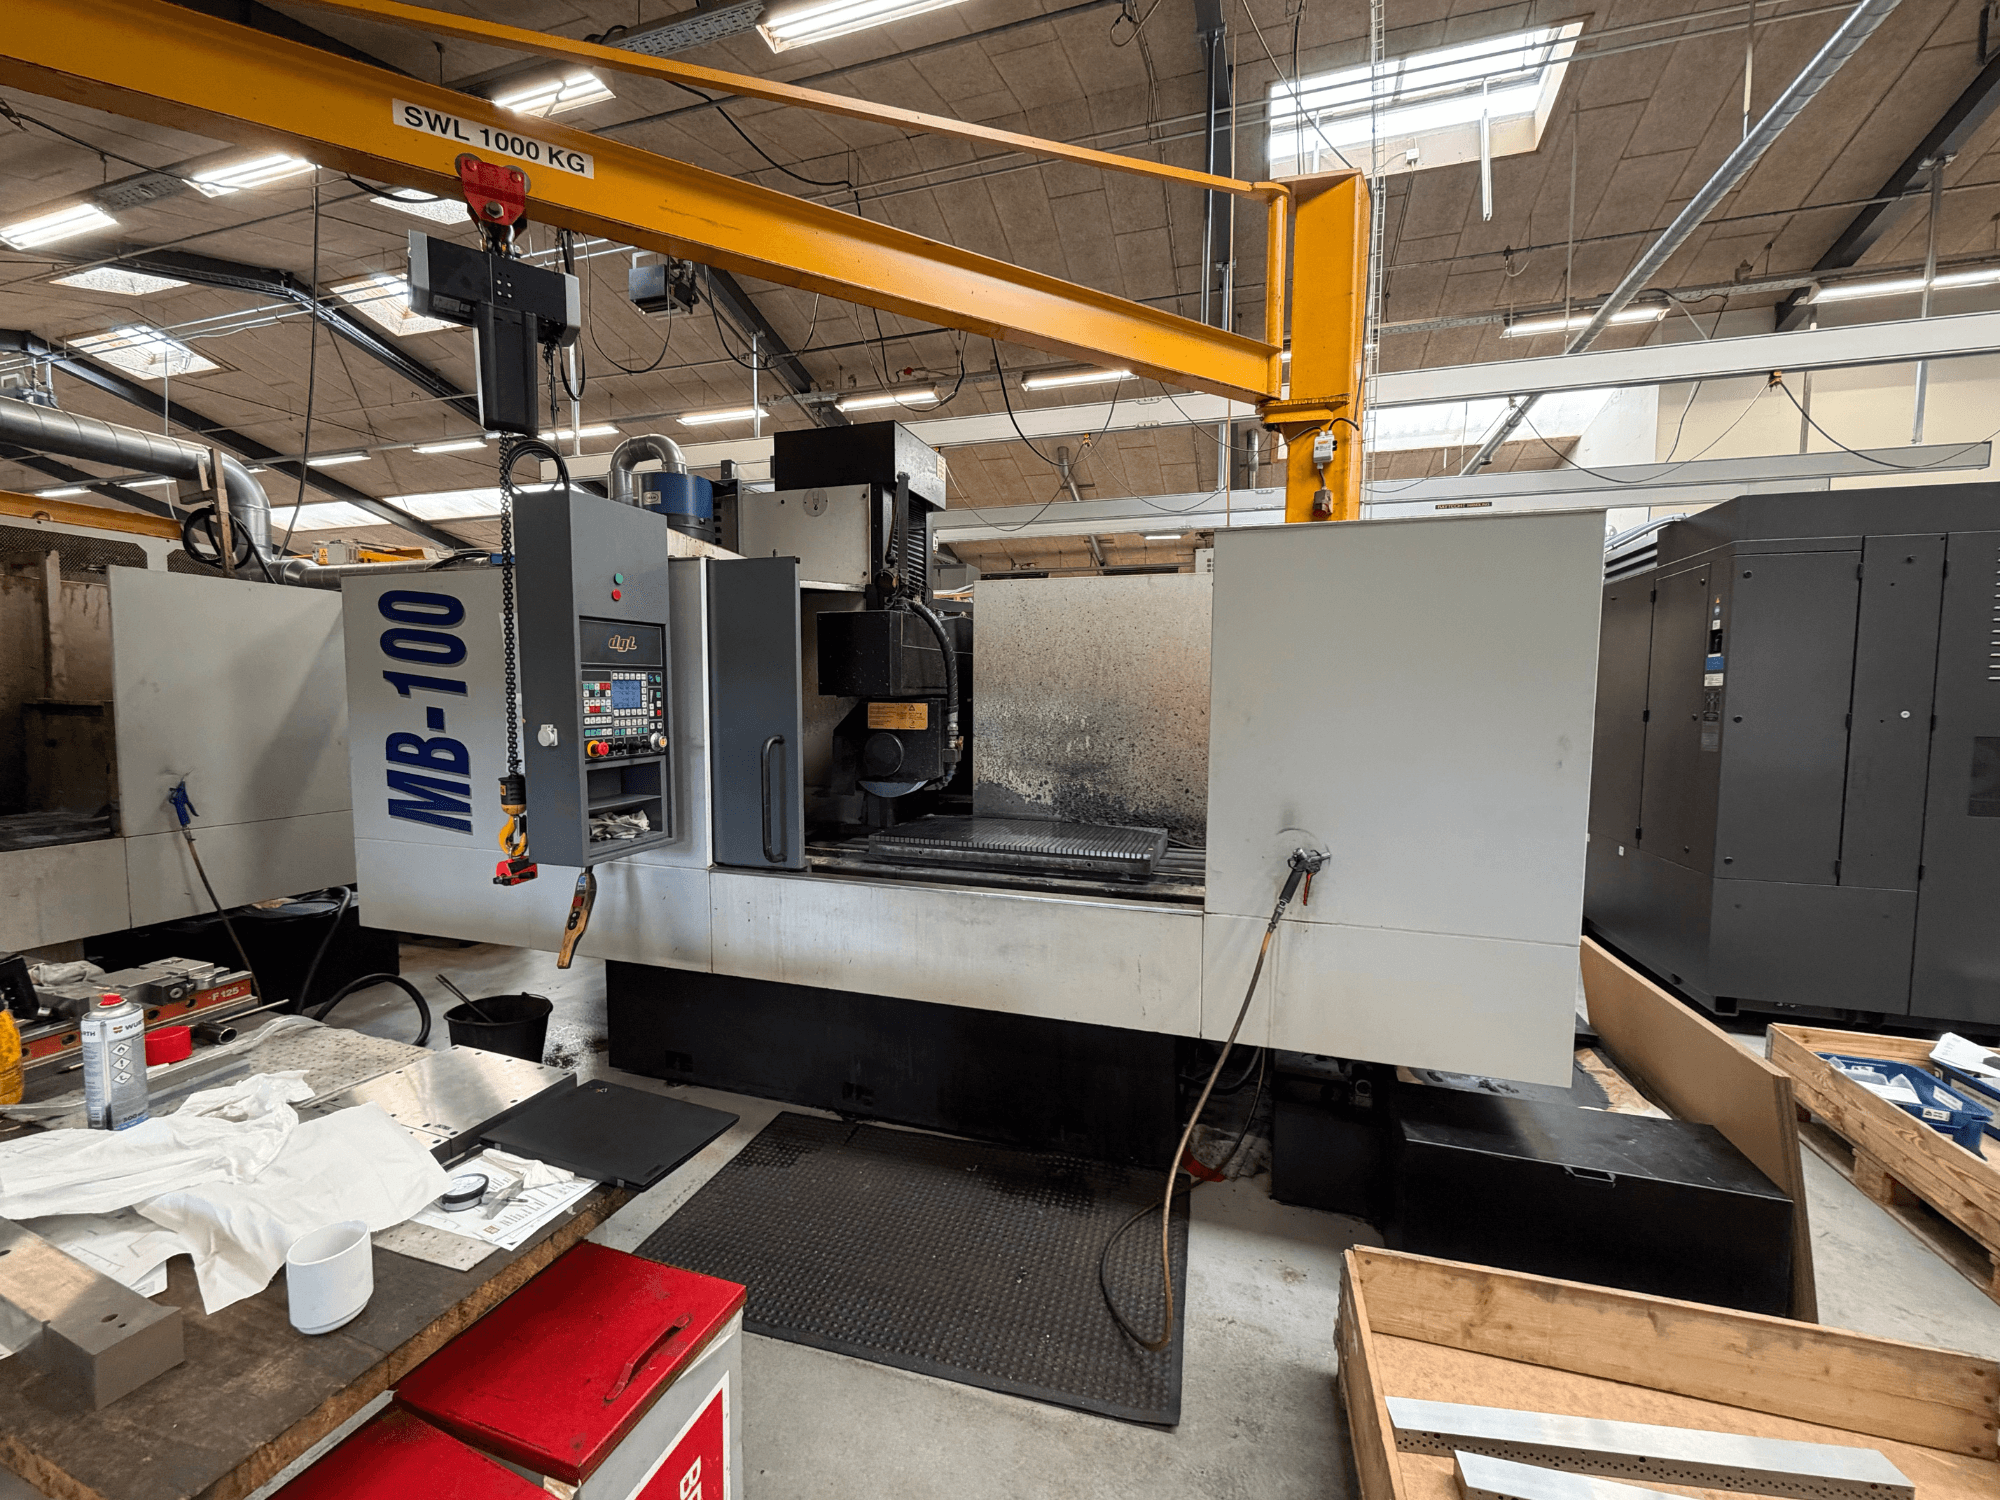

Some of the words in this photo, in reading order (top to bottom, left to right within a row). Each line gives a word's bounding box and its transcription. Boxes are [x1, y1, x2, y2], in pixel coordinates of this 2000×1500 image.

[404, 105, 470, 142] SWL
[480, 128, 540, 161] 1000
[548, 146, 586, 174] KG
[378, 590, 472, 834] MB-100
[212, 992, 219, 1001] F
[220, 986, 240, 998] 125
